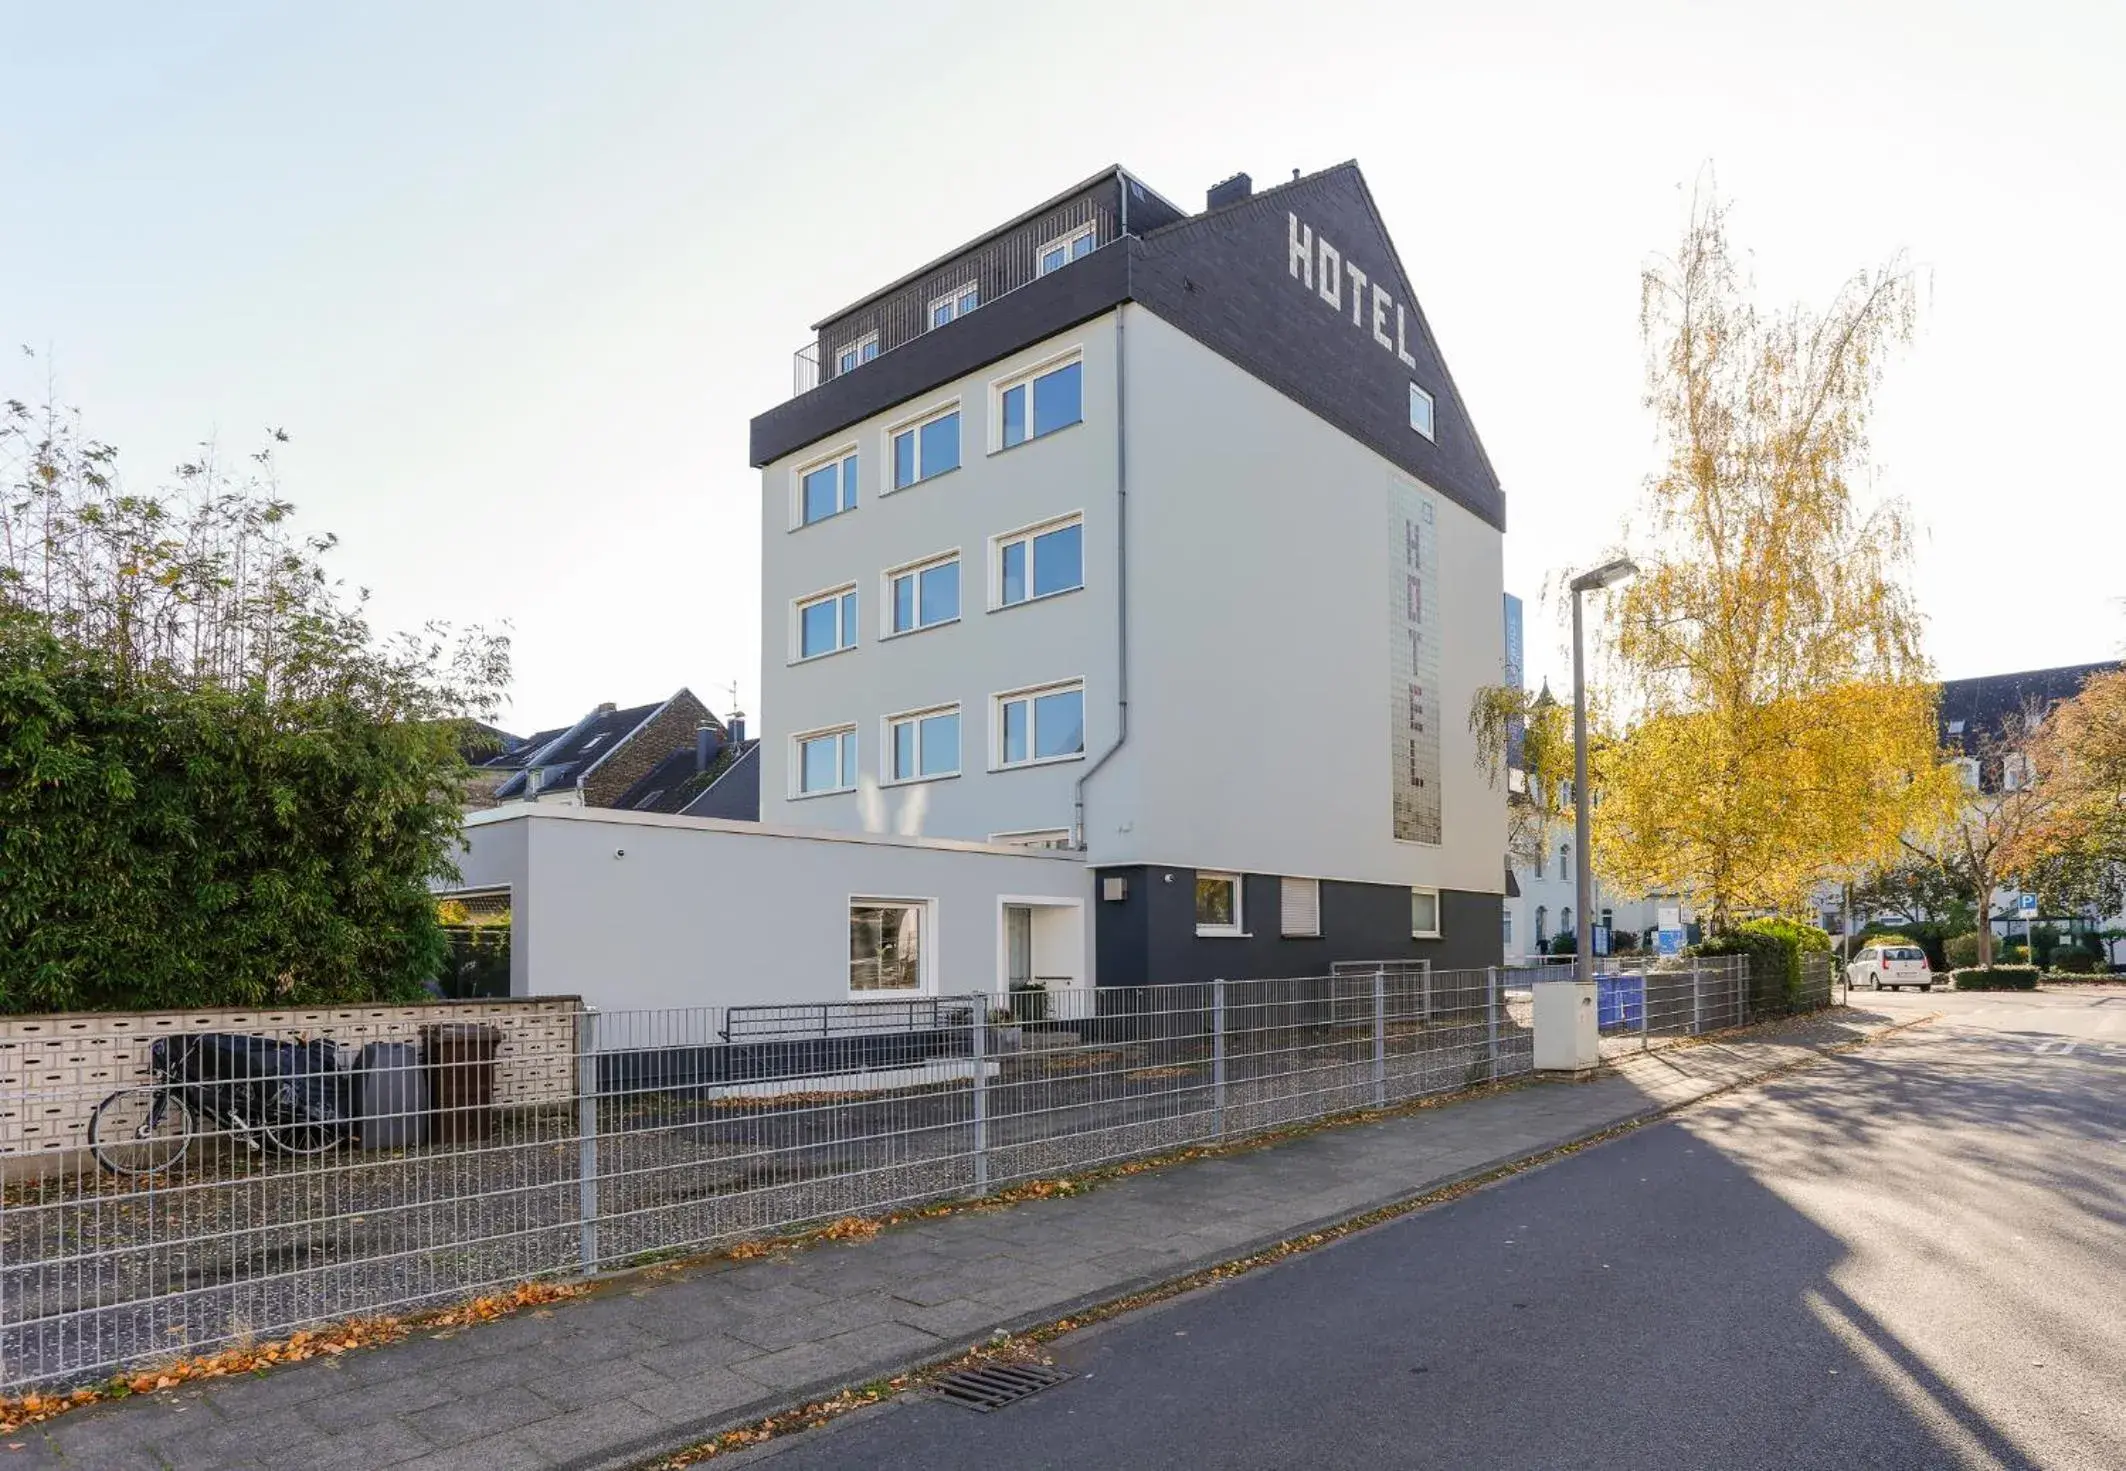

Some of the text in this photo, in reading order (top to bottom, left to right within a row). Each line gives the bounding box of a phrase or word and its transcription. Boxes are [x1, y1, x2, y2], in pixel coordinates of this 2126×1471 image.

[1289, 212, 1416, 370] HOTEL
[1405, 519, 1424, 788] HOTEL
[2022, 895, 2033, 908] P
